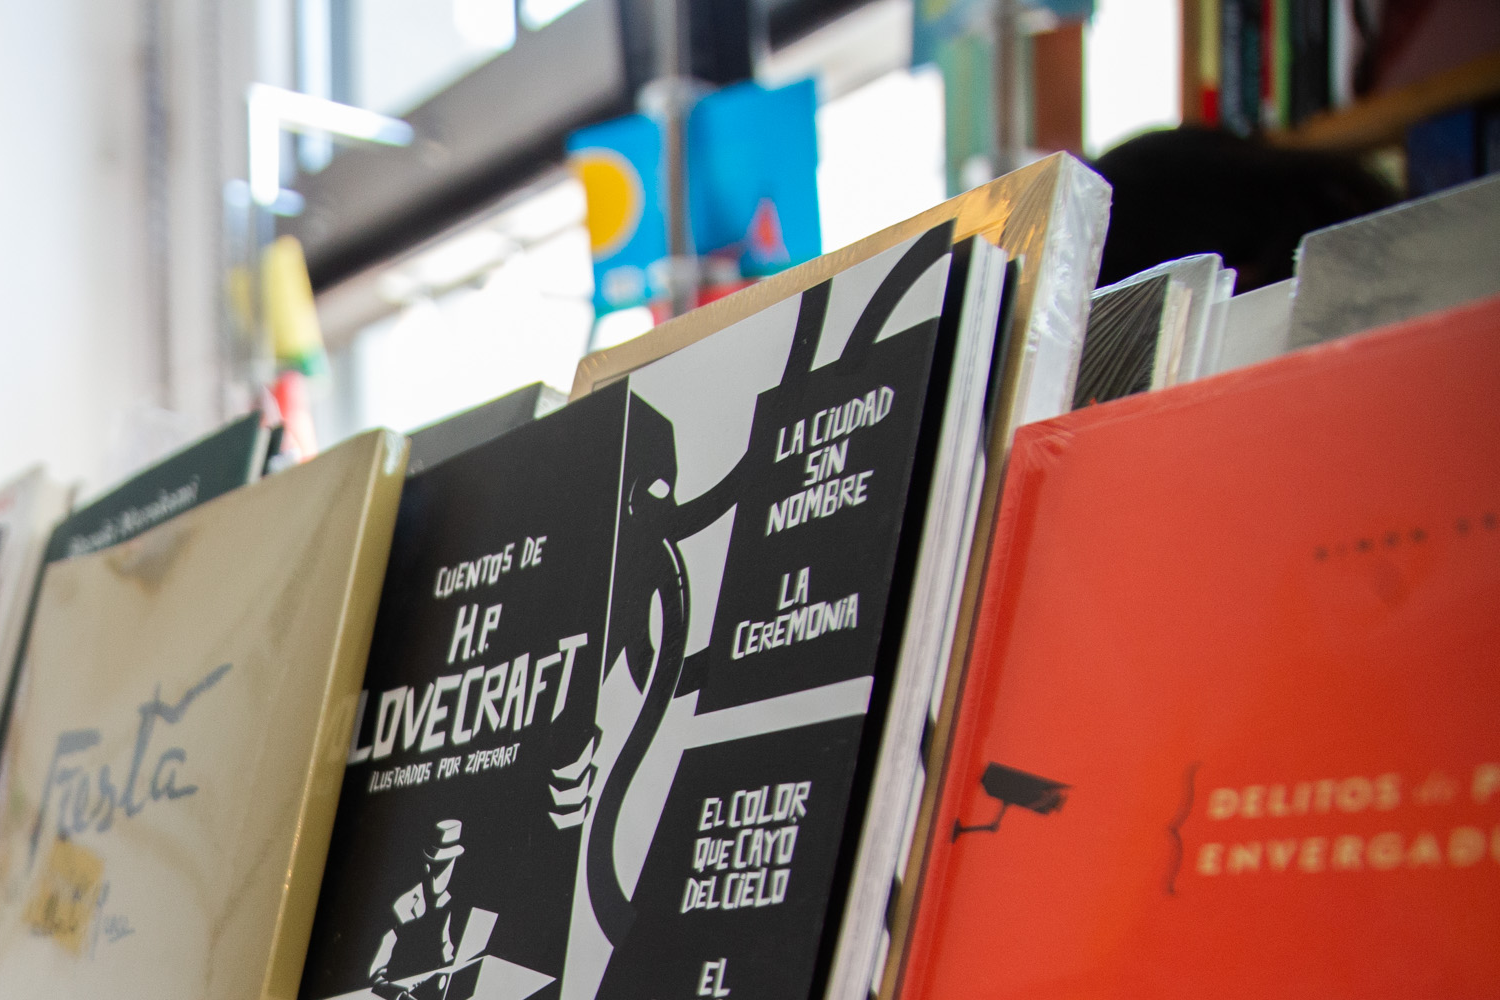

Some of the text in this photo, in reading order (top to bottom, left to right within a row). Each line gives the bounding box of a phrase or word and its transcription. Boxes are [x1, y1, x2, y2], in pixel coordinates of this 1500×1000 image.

[775, 419, 805, 463] LA
[765, 470, 874, 536] NOMBRE
[435, 535, 547, 598] CUENTOS DE
[778, 567, 810, 611] LA
[346, 632, 588, 765] LOVECRAFT
[437, 754, 460, 779] POR
[698, 781, 812, 831] EL COLOR
[1207, 771, 1401, 821] DELITOS
[693, 836, 735, 873] QUE
[681, 876, 720, 914] DEL
[697, 958, 730, 998] EL
